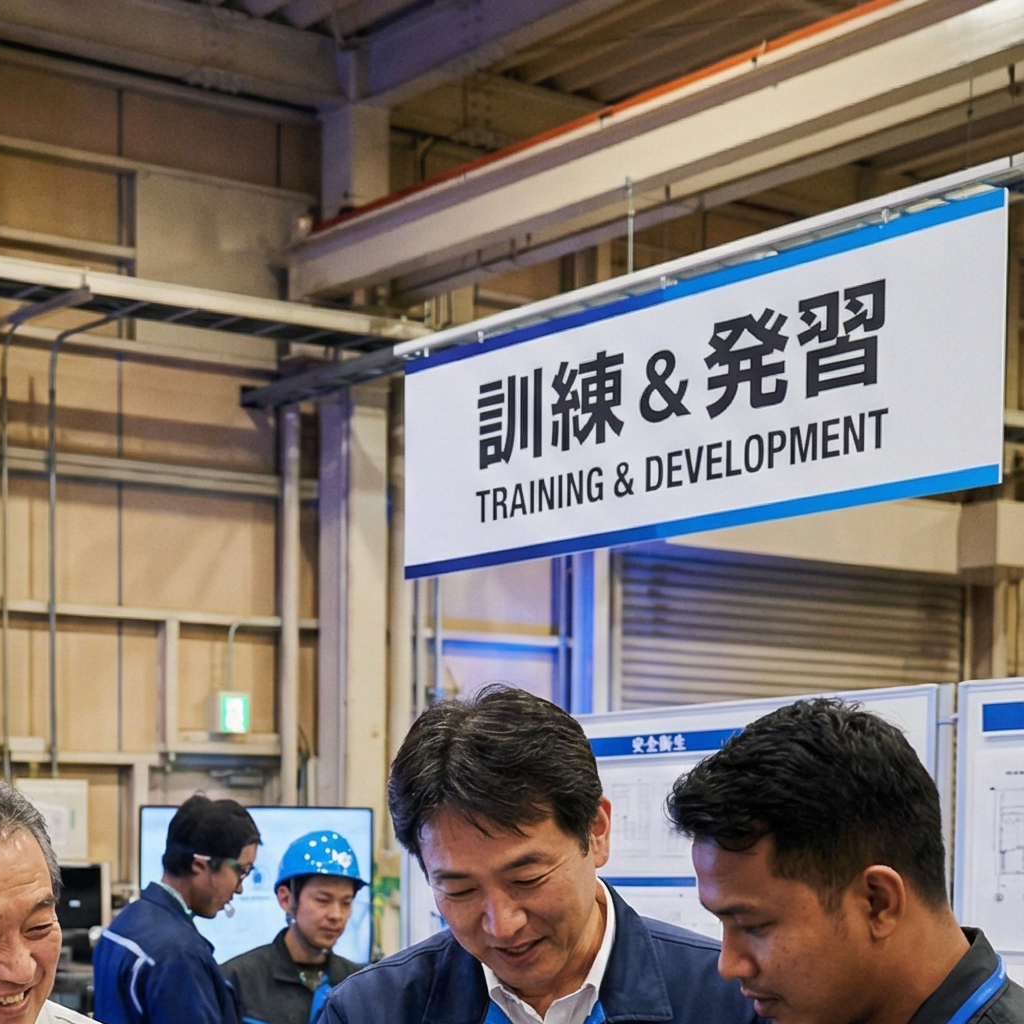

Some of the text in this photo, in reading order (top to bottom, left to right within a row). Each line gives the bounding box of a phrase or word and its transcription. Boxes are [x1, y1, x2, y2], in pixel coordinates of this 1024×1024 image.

[477, 279, 887, 470] 訓練 & 発習
[476, 408, 889, 523] TRAINING & DEVELOPMENT
